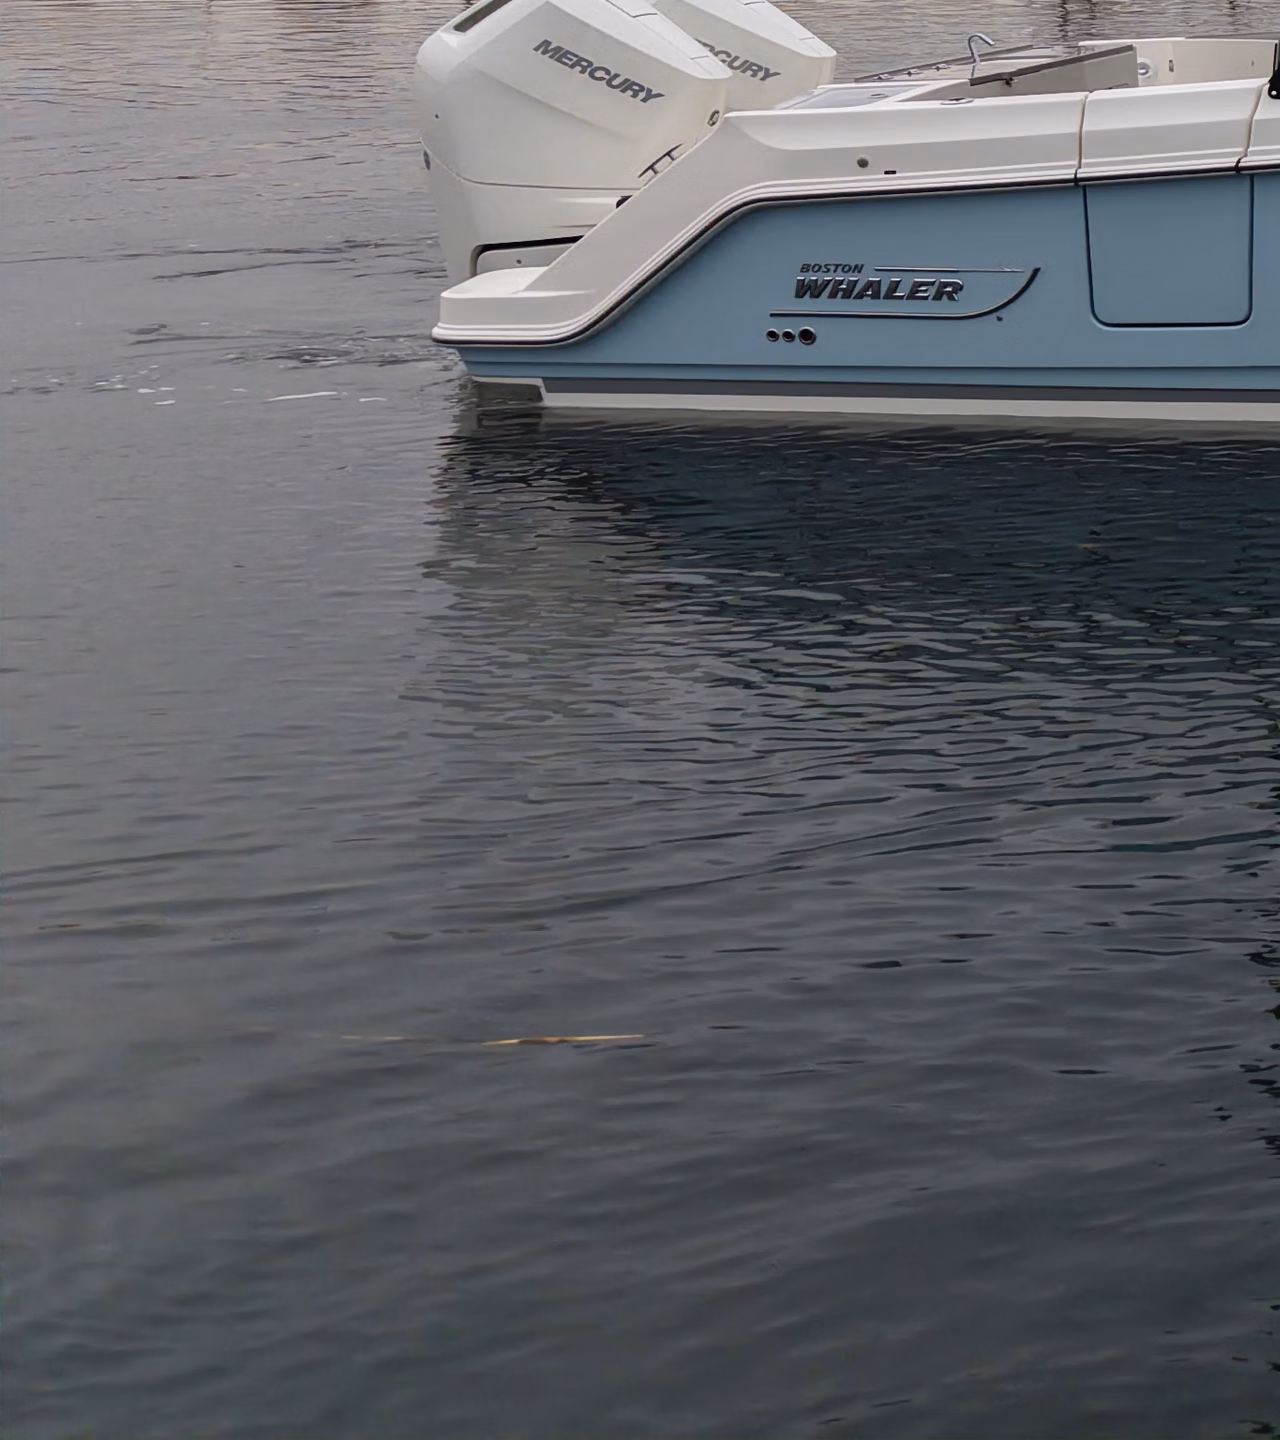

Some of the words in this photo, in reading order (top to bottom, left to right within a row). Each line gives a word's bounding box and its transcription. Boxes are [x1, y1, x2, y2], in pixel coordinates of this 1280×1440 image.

[533, 39, 665, 104] MERCURY
[694, 38, 781, 82] CURY
[800, 263, 864, 274] BOSTON
[794, 276, 964, 301] WHALER
